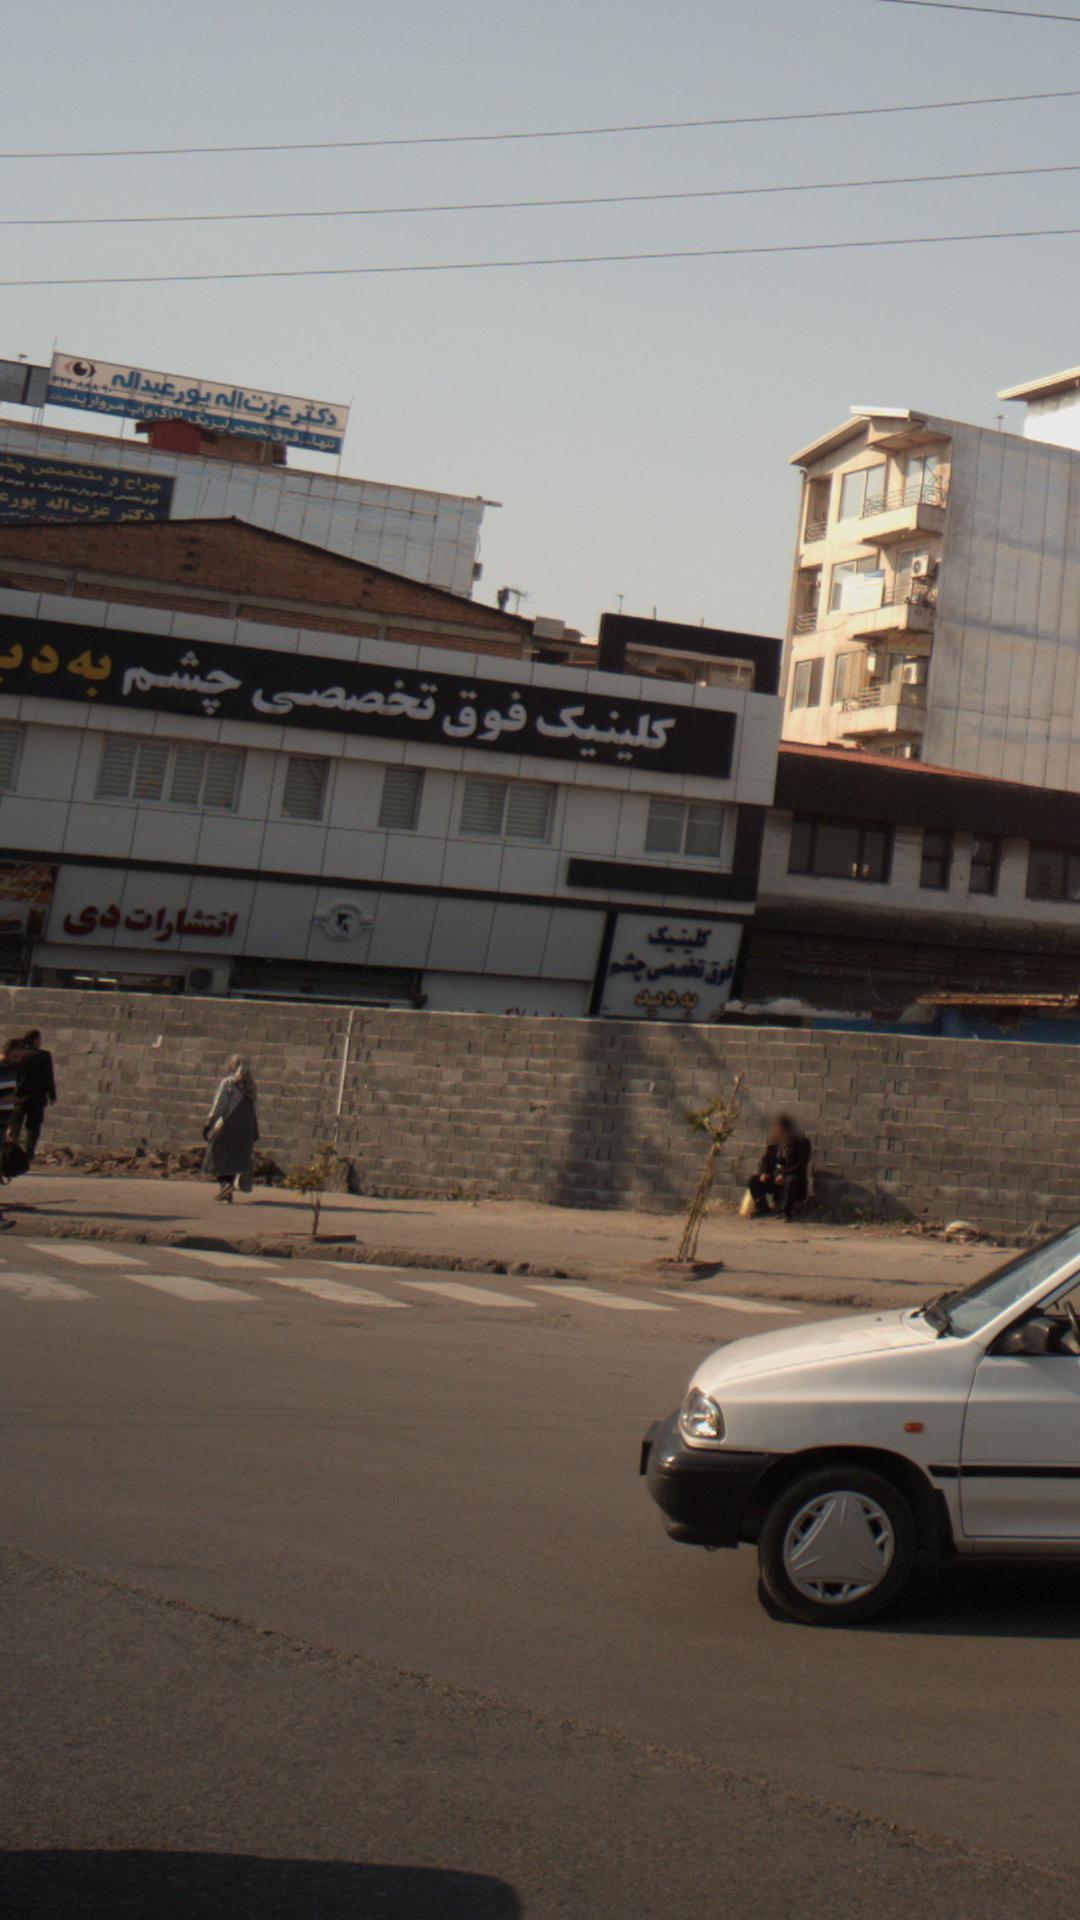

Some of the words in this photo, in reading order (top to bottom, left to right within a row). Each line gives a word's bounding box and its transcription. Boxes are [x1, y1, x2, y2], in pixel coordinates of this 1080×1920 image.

[290, 403, 337, 426] دکتر
[0, 457, 26, 473] چش
[32, 464, 104, 481] متخصص
[124, 476, 162, 491] جراح
[0, 642, 60, 684] دی
[121, 650, 243, 716] چشم
[251, 679, 436, 722] تخصصی
[441, 690, 528, 741] فوق
[536, 704, 676, 761] کلینیک
[62, 903, 121, 936] دی
[124, 905, 239, 942] انتشارات
[647, 925, 712, 955] کلینیک
[609, 952, 647, 983] چشم
[645, 957, 707, 983] تخصصی
[705, 958, 736, 986] فوق
